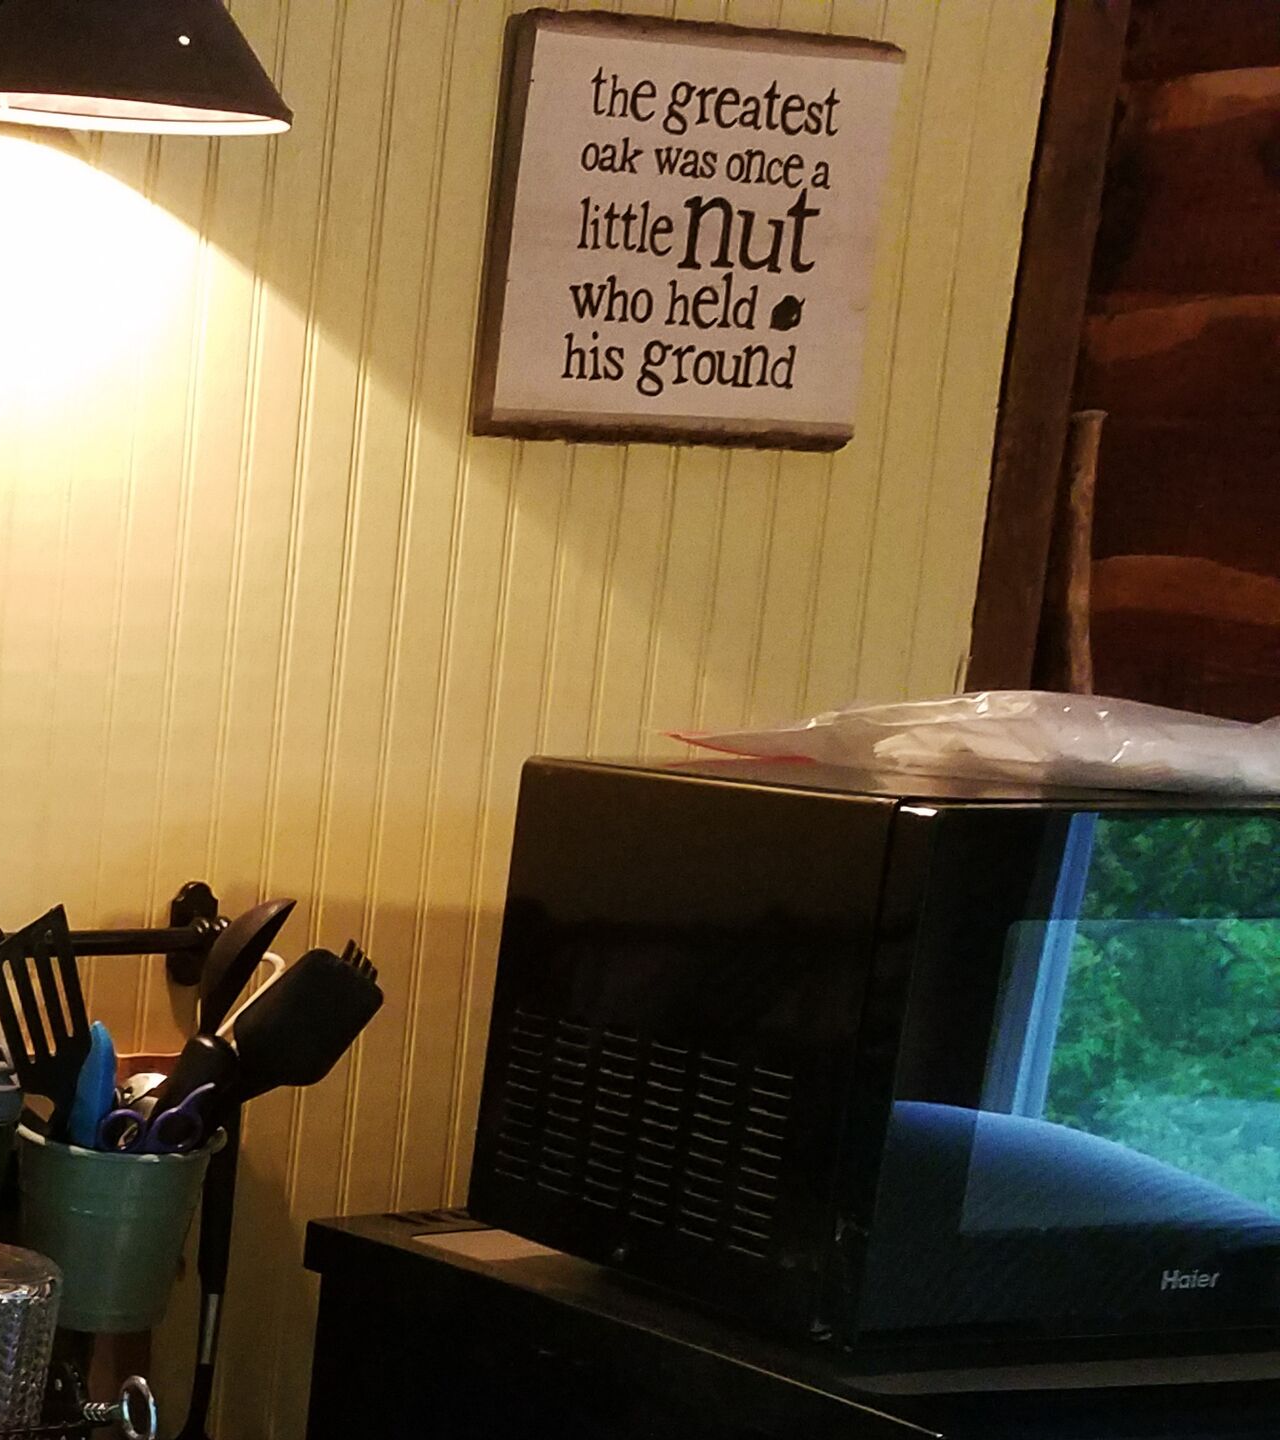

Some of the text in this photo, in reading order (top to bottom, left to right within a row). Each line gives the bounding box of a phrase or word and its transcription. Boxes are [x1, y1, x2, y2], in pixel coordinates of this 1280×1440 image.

[591, 67, 840, 137] the greatest
[581, 138, 831, 190] oak was once a
[577, 188, 821, 274] little nut
[570, 273, 759, 330] who held
[561, 332, 798, 397] his ground
[1160, 1269, 1220, 1291] Haier
